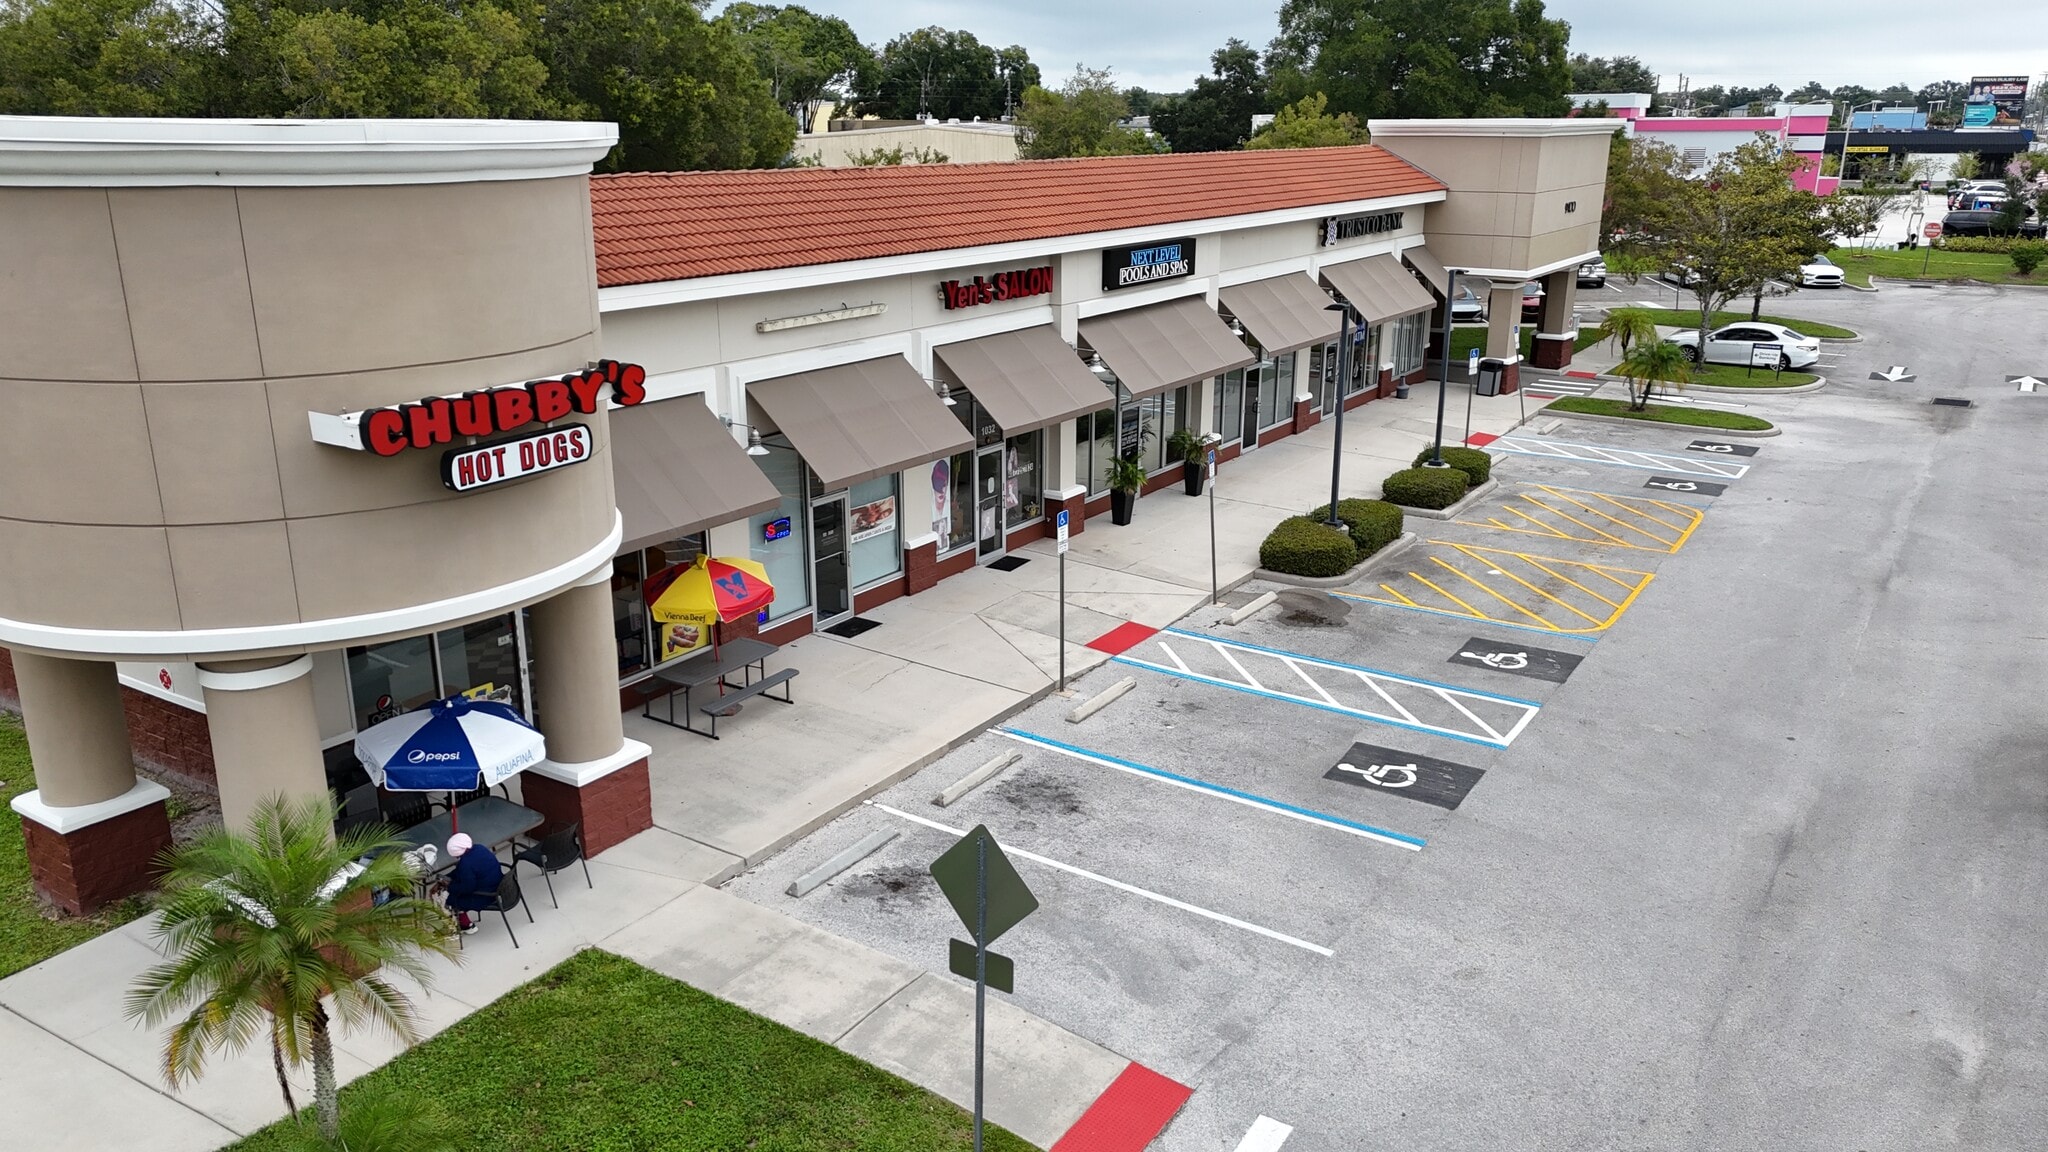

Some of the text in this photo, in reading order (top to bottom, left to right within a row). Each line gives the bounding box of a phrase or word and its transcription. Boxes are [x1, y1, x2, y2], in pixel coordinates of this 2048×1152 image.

[1338, 212, 1404, 239] TRUSTCO BANK
[1131, 244, 1181, 266] NEXT LEVEL
[1121, 258, 1189, 284] POOLS AND SPAS
[941, 266, 1053, 310] Yen's SALON
[1354, 331, 1365, 343] ATM
[359, 359, 646, 458] CHUBBY'S
[980, 424, 996, 436] 1032
[457, 430, 585, 487] HOT DOGS
[664, 612, 706, 624] Vienna Beef
[425, 751, 460, 762] pepsi
[496, 749, 533, 780] AQUAFINA
